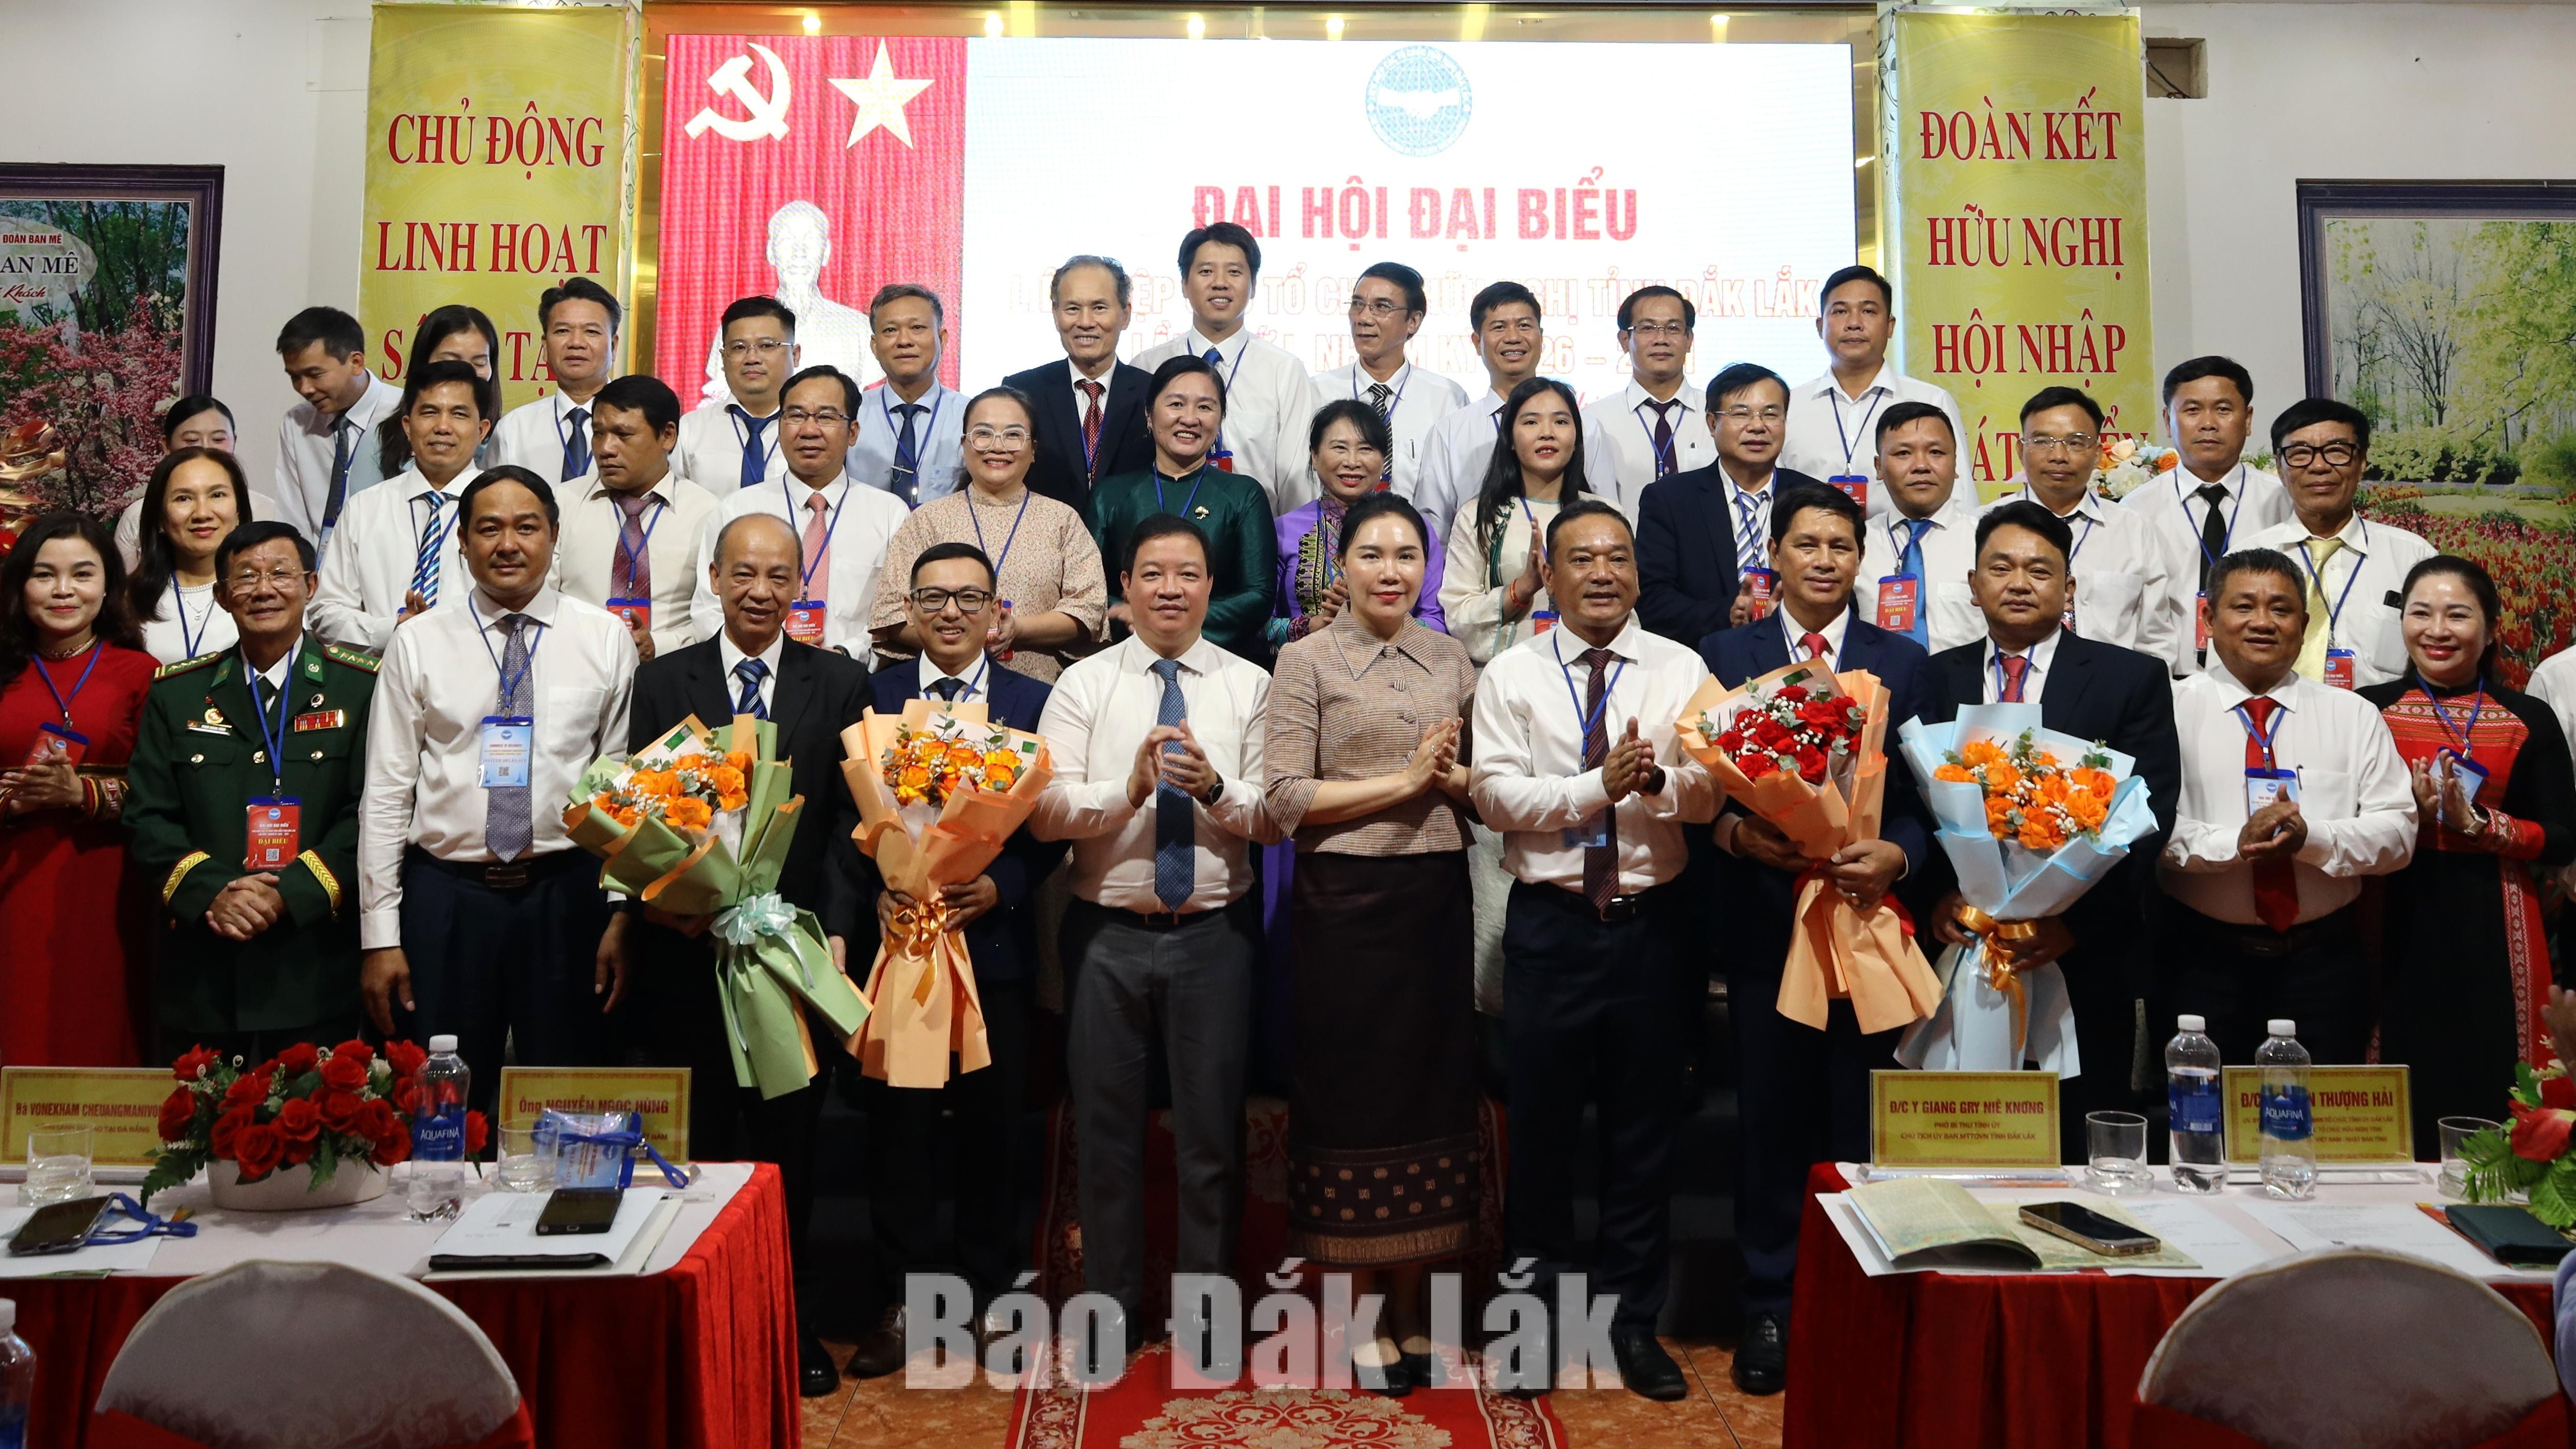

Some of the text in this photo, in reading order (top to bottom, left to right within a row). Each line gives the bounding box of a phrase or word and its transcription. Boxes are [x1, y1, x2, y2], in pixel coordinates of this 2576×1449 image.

[1920, 87, 2121, 161] ĐOÀN KẾT
[389, 98, 605, 180] CHỦ ĐỘNG
[1301, 175, 1388, 251] HỘI
[1408, 187, 1497, 252] ĐẠI
[1517, 165, 1637, 242] BIỂU
[3, 233, 62, 244] ĐOÀN BAN MÊ
[1927, 203, 2124, 281] HỮU NGHỊ
[41, 251, 78, 274] MÊ
[376, 221, 607, 285] LINH HOẠT
[3, 284, 46, 303] Khách
[1263, 262, 1307, 315] TỔ
[1754, 265, 1819, 317] LẮK
[1932, 308, 2126, 388] HỘI NHẬP
[505, 331, 569, 397] TẠ
[30, 1102, 79, 1116] VONEKHAM
[546, 1095, 595, 1111] NGUYỄN
[635, 1097, 669, 1114] HÙNG
[1889, 1098, 2044, 1115] Đ/C Y GIANG GRY NIÊ KNƠNG
[2319, 1089, 2369, 1110] THƯỢNG
[2372, 1086, 2394, 1107] HẢI
[2266, 1107, 2303, 1120] AQUAFINA
[420, 1127, 460, 1141] AQUAFINA
